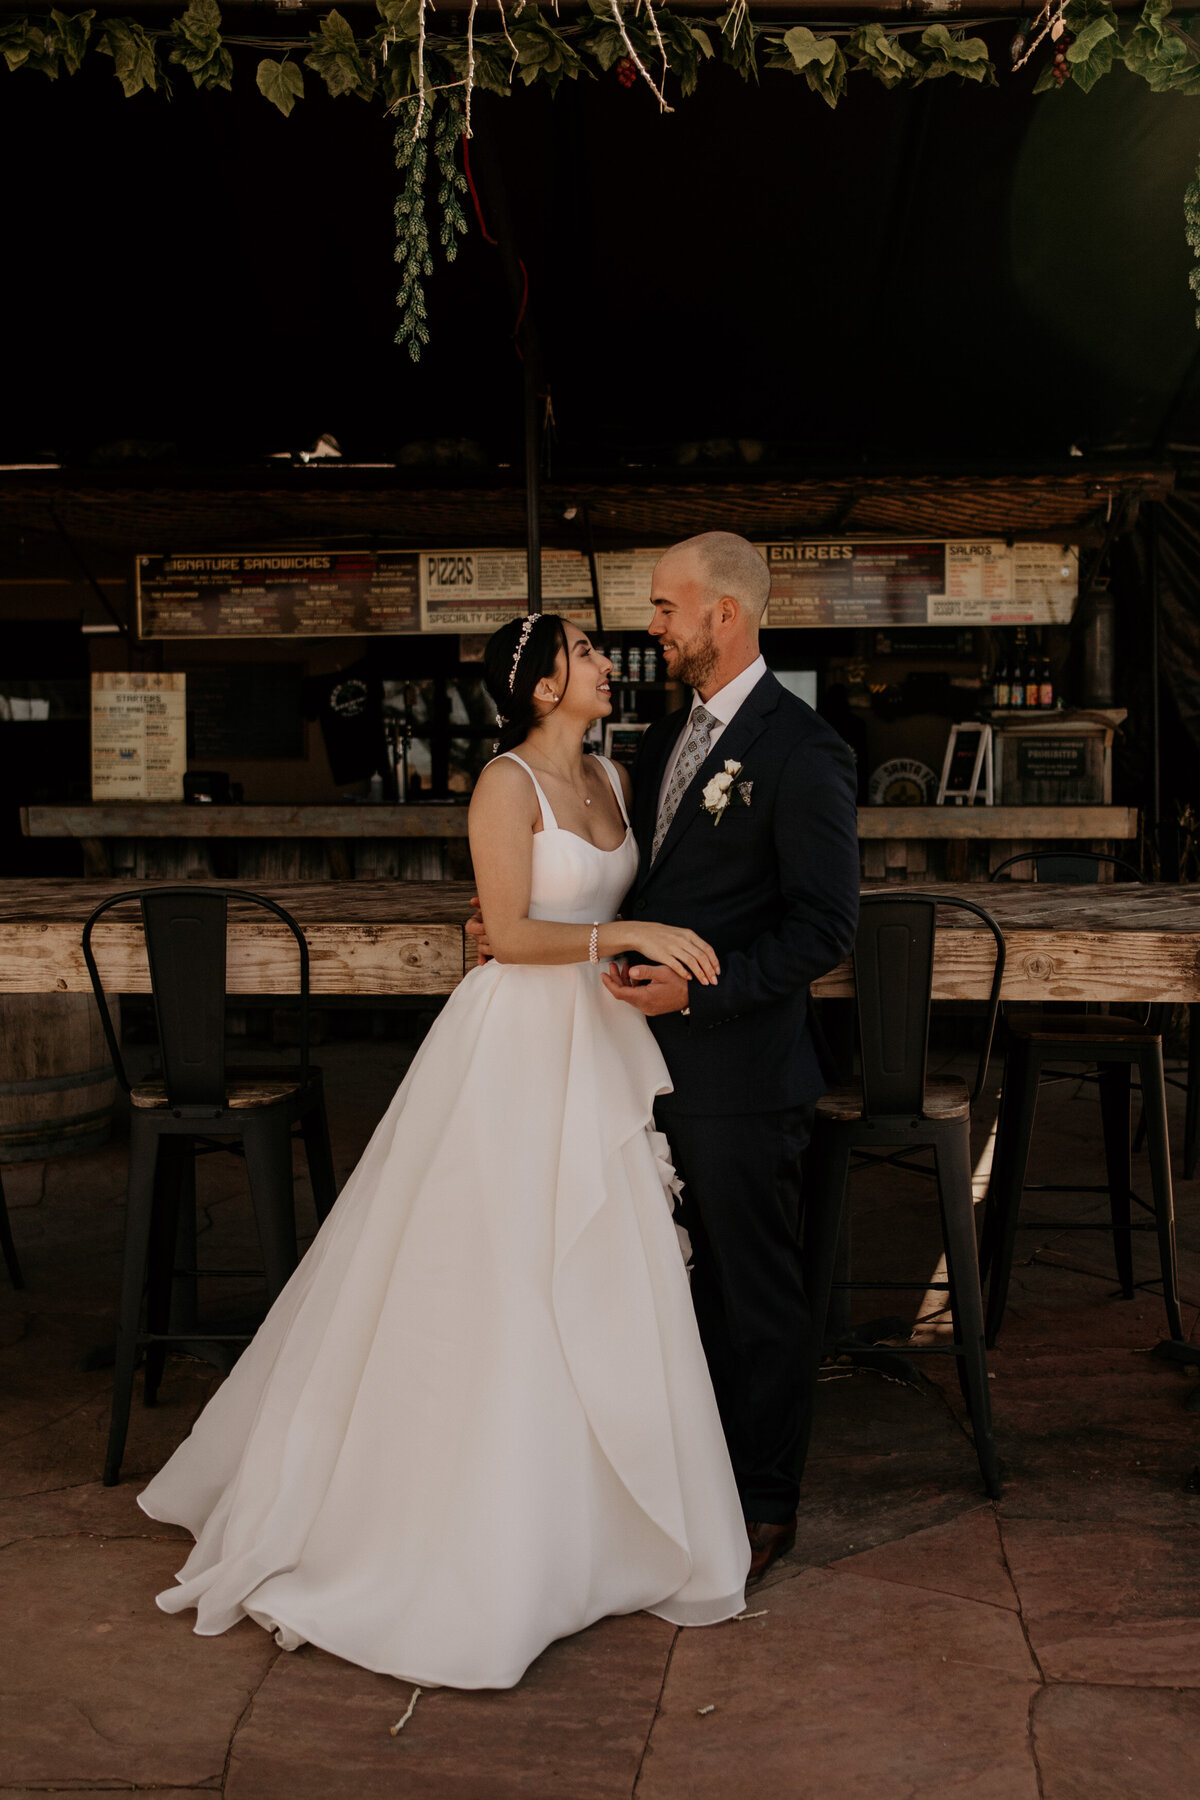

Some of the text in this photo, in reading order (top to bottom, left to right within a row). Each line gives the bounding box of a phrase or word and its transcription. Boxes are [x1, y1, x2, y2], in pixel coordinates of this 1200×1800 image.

[770, 546, 853, 560] ENTREES
[949, 546, 992, 555] SALADS
[243, 556, 331, 570] SANDWICHES
[428, 556, 473, 585] PIZZAS
[429, 613, 482, 623] SPECIALTY
[116, 694, 161, 703] STARTERS
[1027, 750, 1078, 759] PROHIBITED
[883, 760, 921, 776] SANTA
